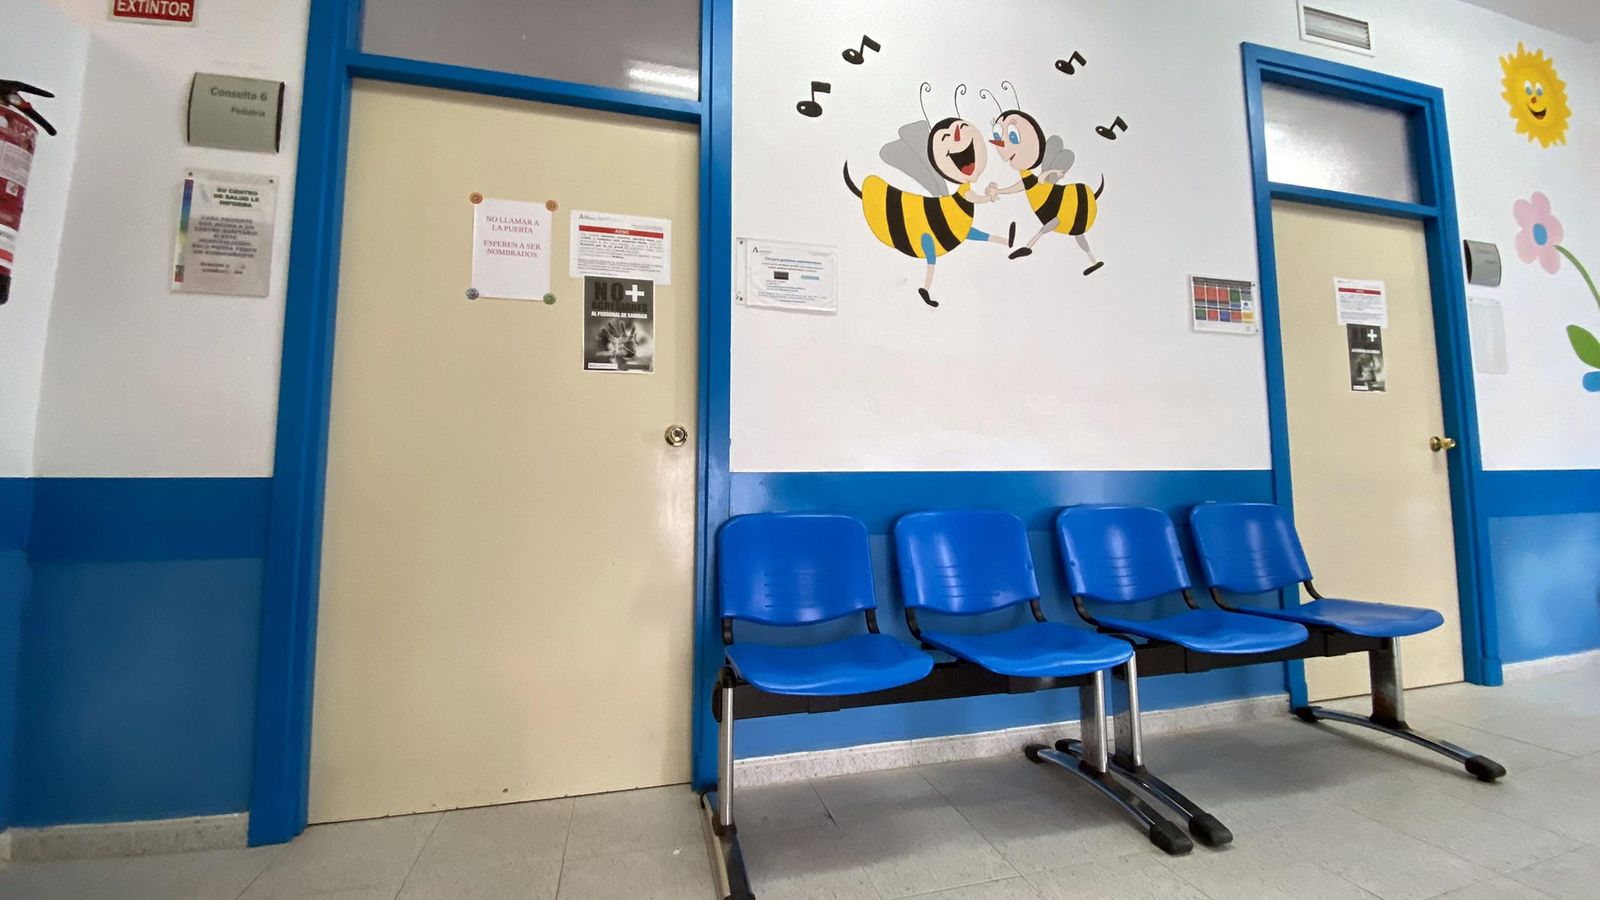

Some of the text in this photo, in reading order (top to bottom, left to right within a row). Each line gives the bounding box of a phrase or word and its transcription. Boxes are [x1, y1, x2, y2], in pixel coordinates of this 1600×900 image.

[117, 0, 190, 17] EXTINTOR
[210, 87, 268, 102] Consulta 6
[500, 216, 532, 225] LLAMAR
[484, 240, 517, 248] ESPEREN
[487, 248, 538, 258] NOMBRADOS
